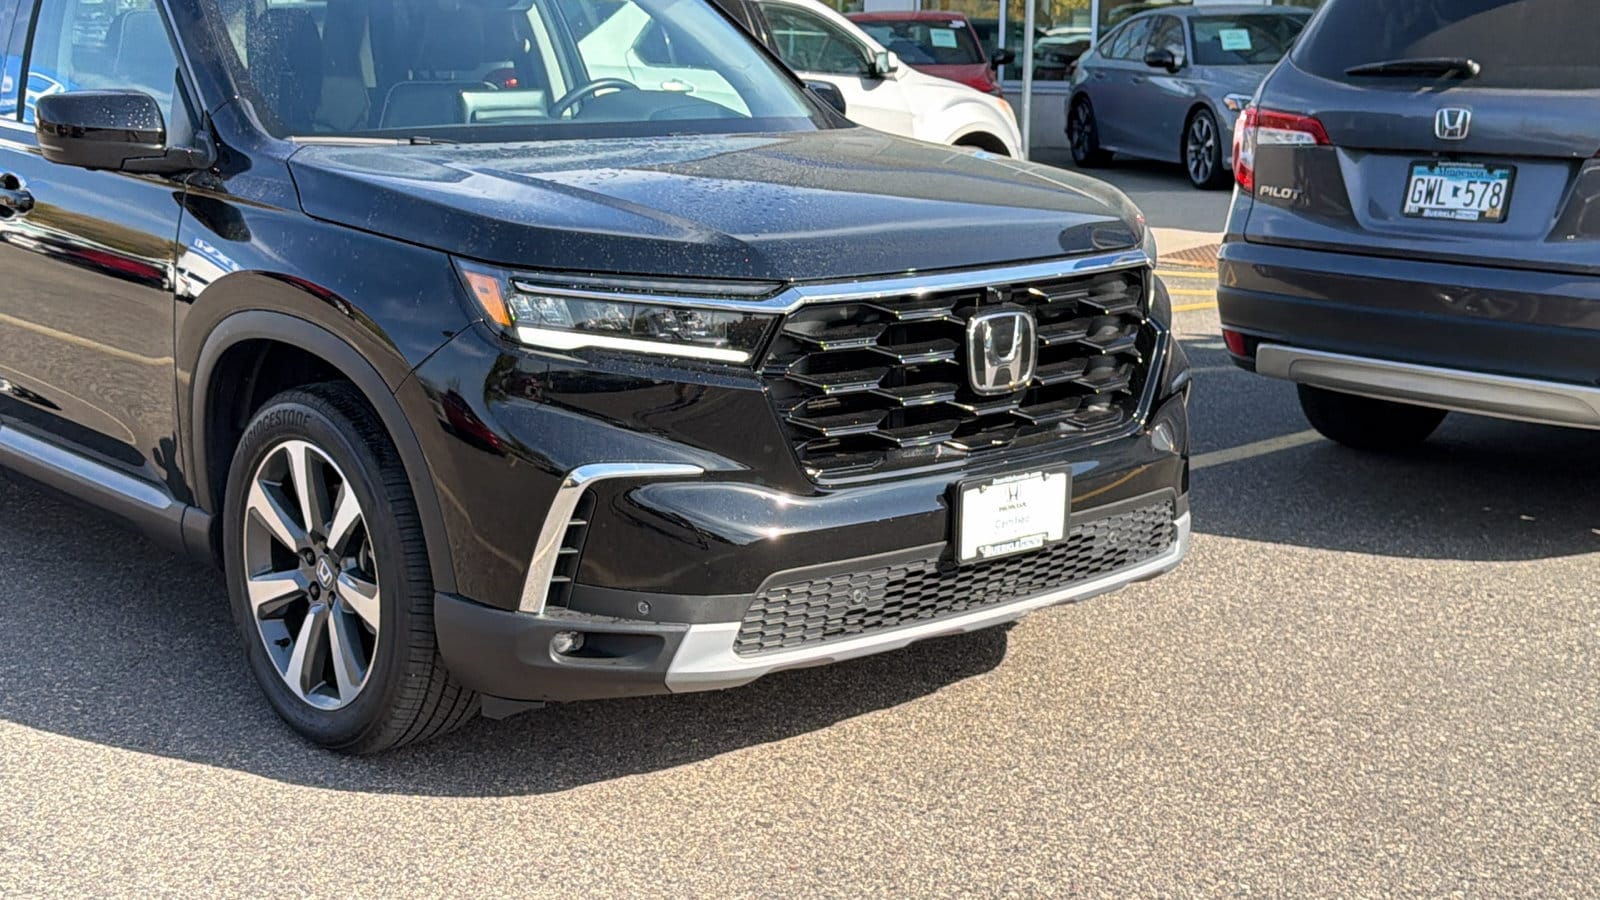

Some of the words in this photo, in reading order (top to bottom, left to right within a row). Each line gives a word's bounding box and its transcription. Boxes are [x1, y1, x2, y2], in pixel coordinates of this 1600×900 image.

[1260, 185, 1302, 200] PILOT
[1410, 178, 1446, 205] GWL
[1463, 180, 1503, 208] 578
